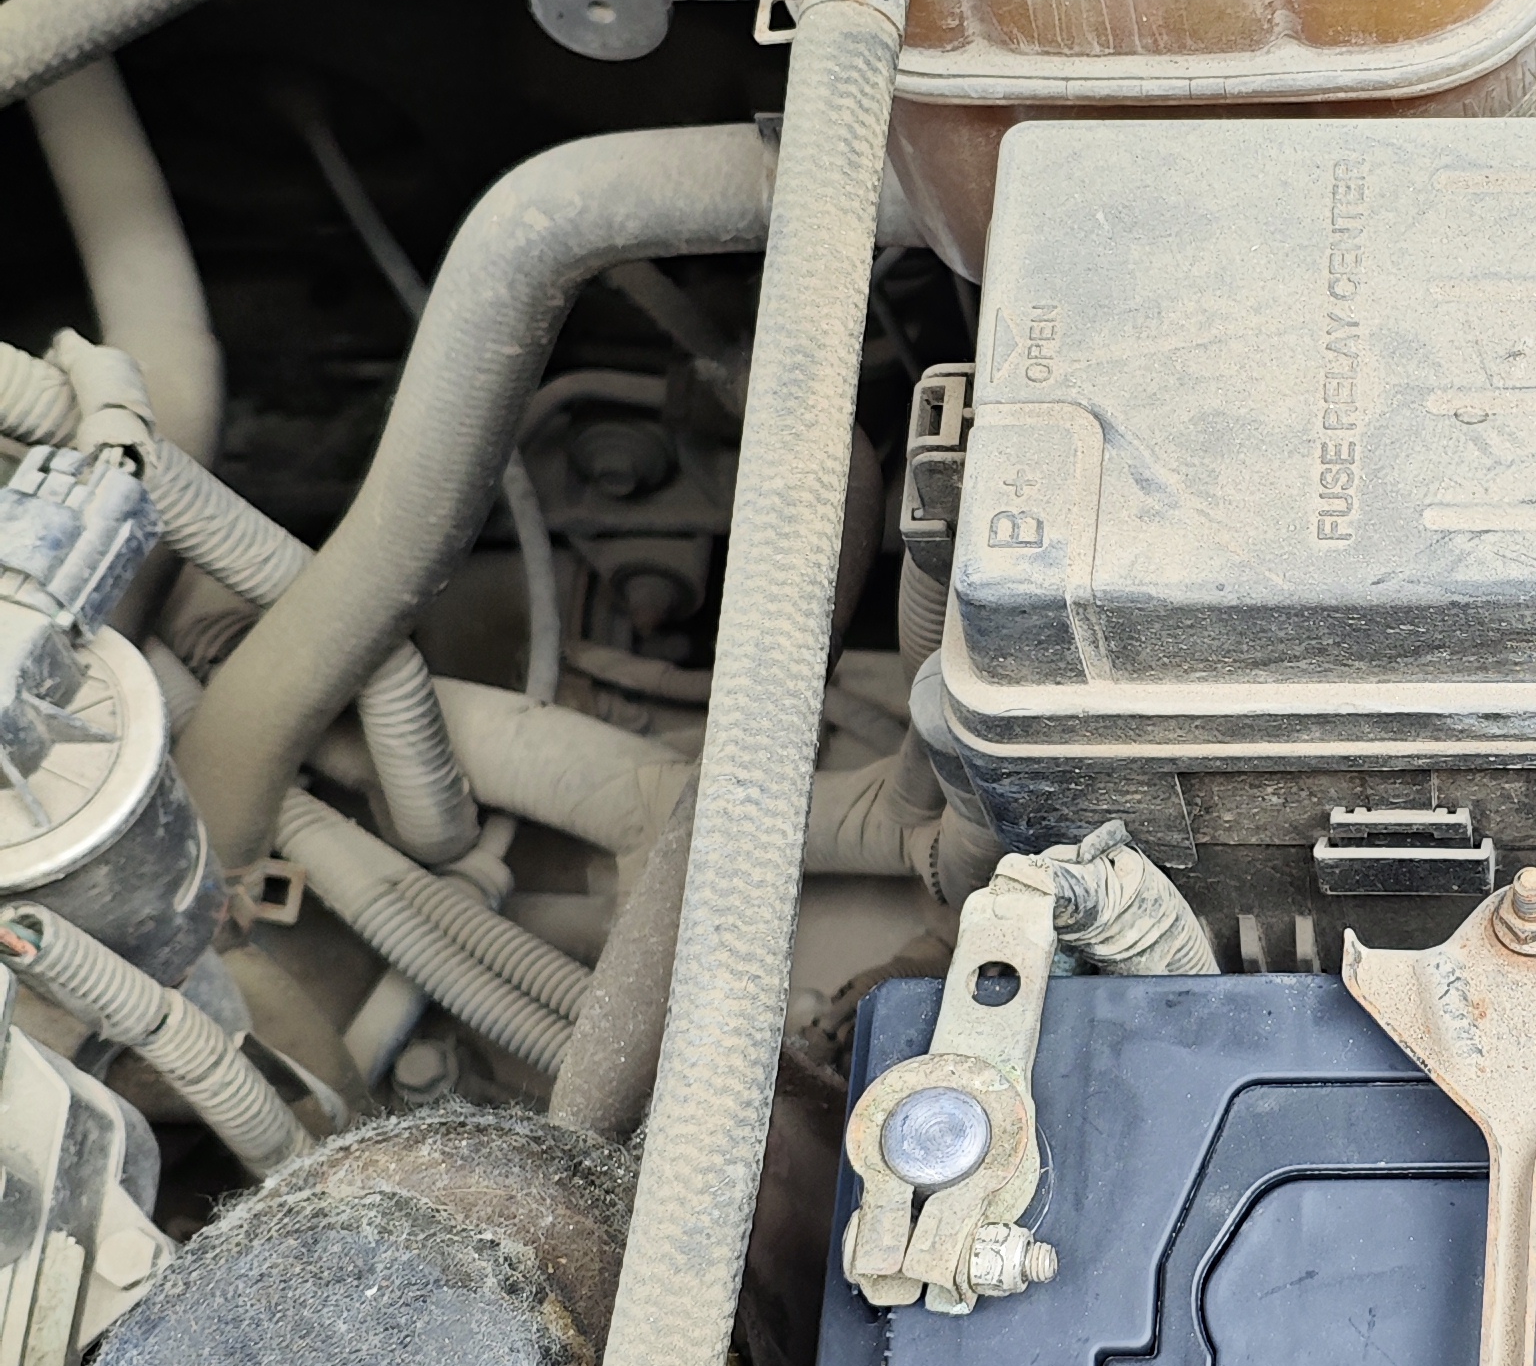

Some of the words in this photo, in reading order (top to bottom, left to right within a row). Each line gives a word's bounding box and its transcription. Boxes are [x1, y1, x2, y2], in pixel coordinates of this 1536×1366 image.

[1327, 156, 1369, 303] CENTER
[1025, 303, 1060, 385] OPEN
[1321, 312, 1361, 433] RELAY
[1316, 440, 1357, 542] FUSE
